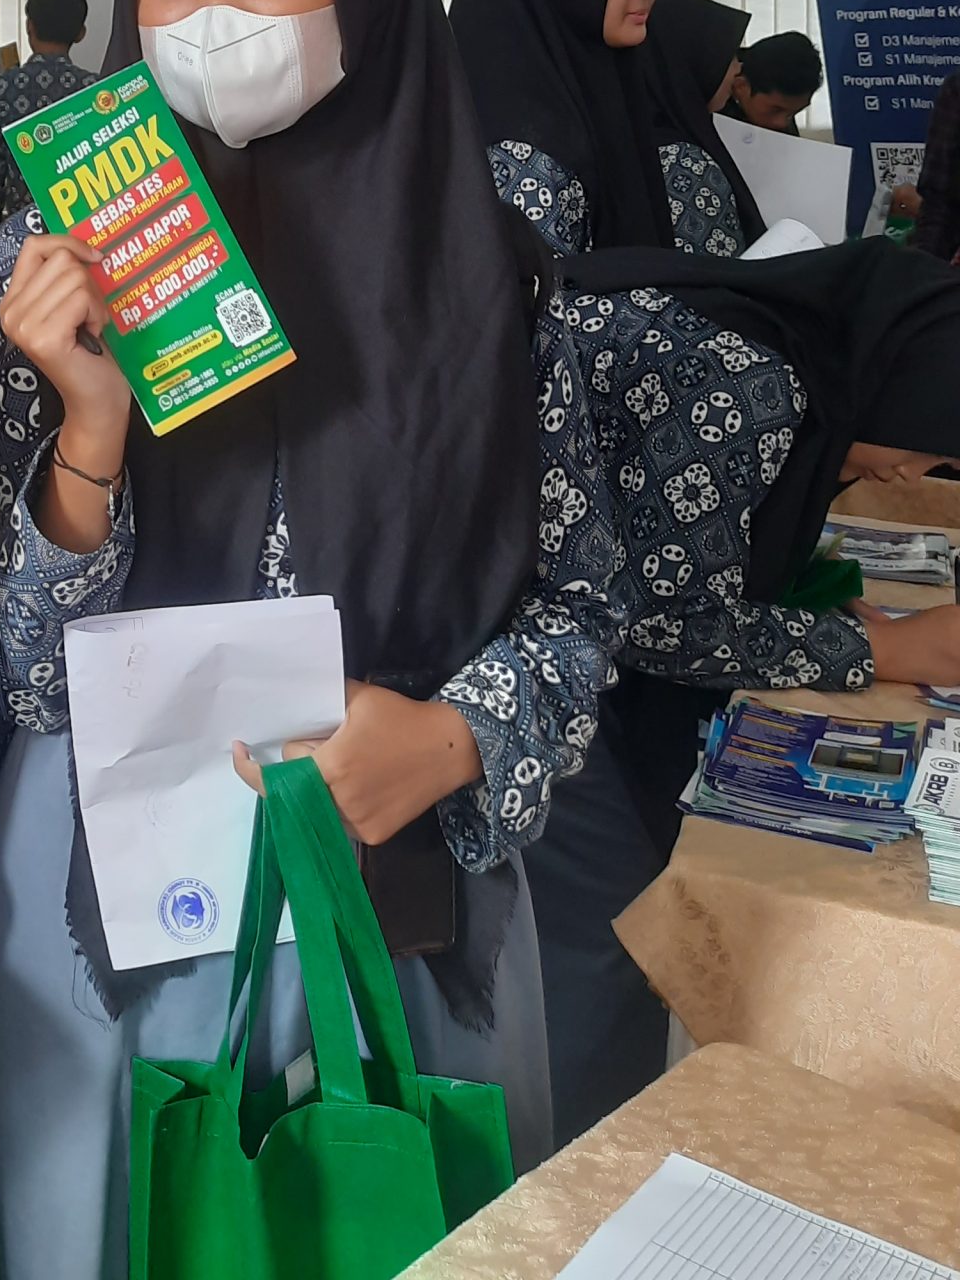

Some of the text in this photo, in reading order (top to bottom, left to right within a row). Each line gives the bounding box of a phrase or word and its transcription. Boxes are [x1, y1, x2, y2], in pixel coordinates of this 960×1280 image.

[836, 10, 887, 22] Program
[889, 6, 935, 20] Reguler
[937, 6, 946, 17] &
[882, 35, 900, 47] D3
[885, 54, 901, 65] S1
[843, 75, 894, 89] Program
[897, 74, 921, 85] Alih
[891, 98, 907, 109] S1
[55, 140, 93, 174] JALUR
[92, 106, 140, 147] SELEKSI
[48, 114, 175, 228] PMDK
[87, 175, 184, 248] EBAS BIAYA PENDAFTARAN
[90, 172, 163, 232] BEBAS TES
[101, 204, 191, 276] PAKAI RAPOR
[111, 263, 133, 282] NILAI
[132, 234, 172, 267] SEMESTER
[172, 229, 179, 238] 1
[185, 220, 192, 230] 5
[112, 235, 215, 313] DAPATKAN POTONGAN HINGGA
[183, 290, 190, 298] DI
[191, 270, 219, 294] SEMESTER
[214, 280, 246, 303] SCAN ME
[120, 305, 142, 326] Rp
[192, 324, 213, 338] Online
[242, 342, 261, 357] Media
